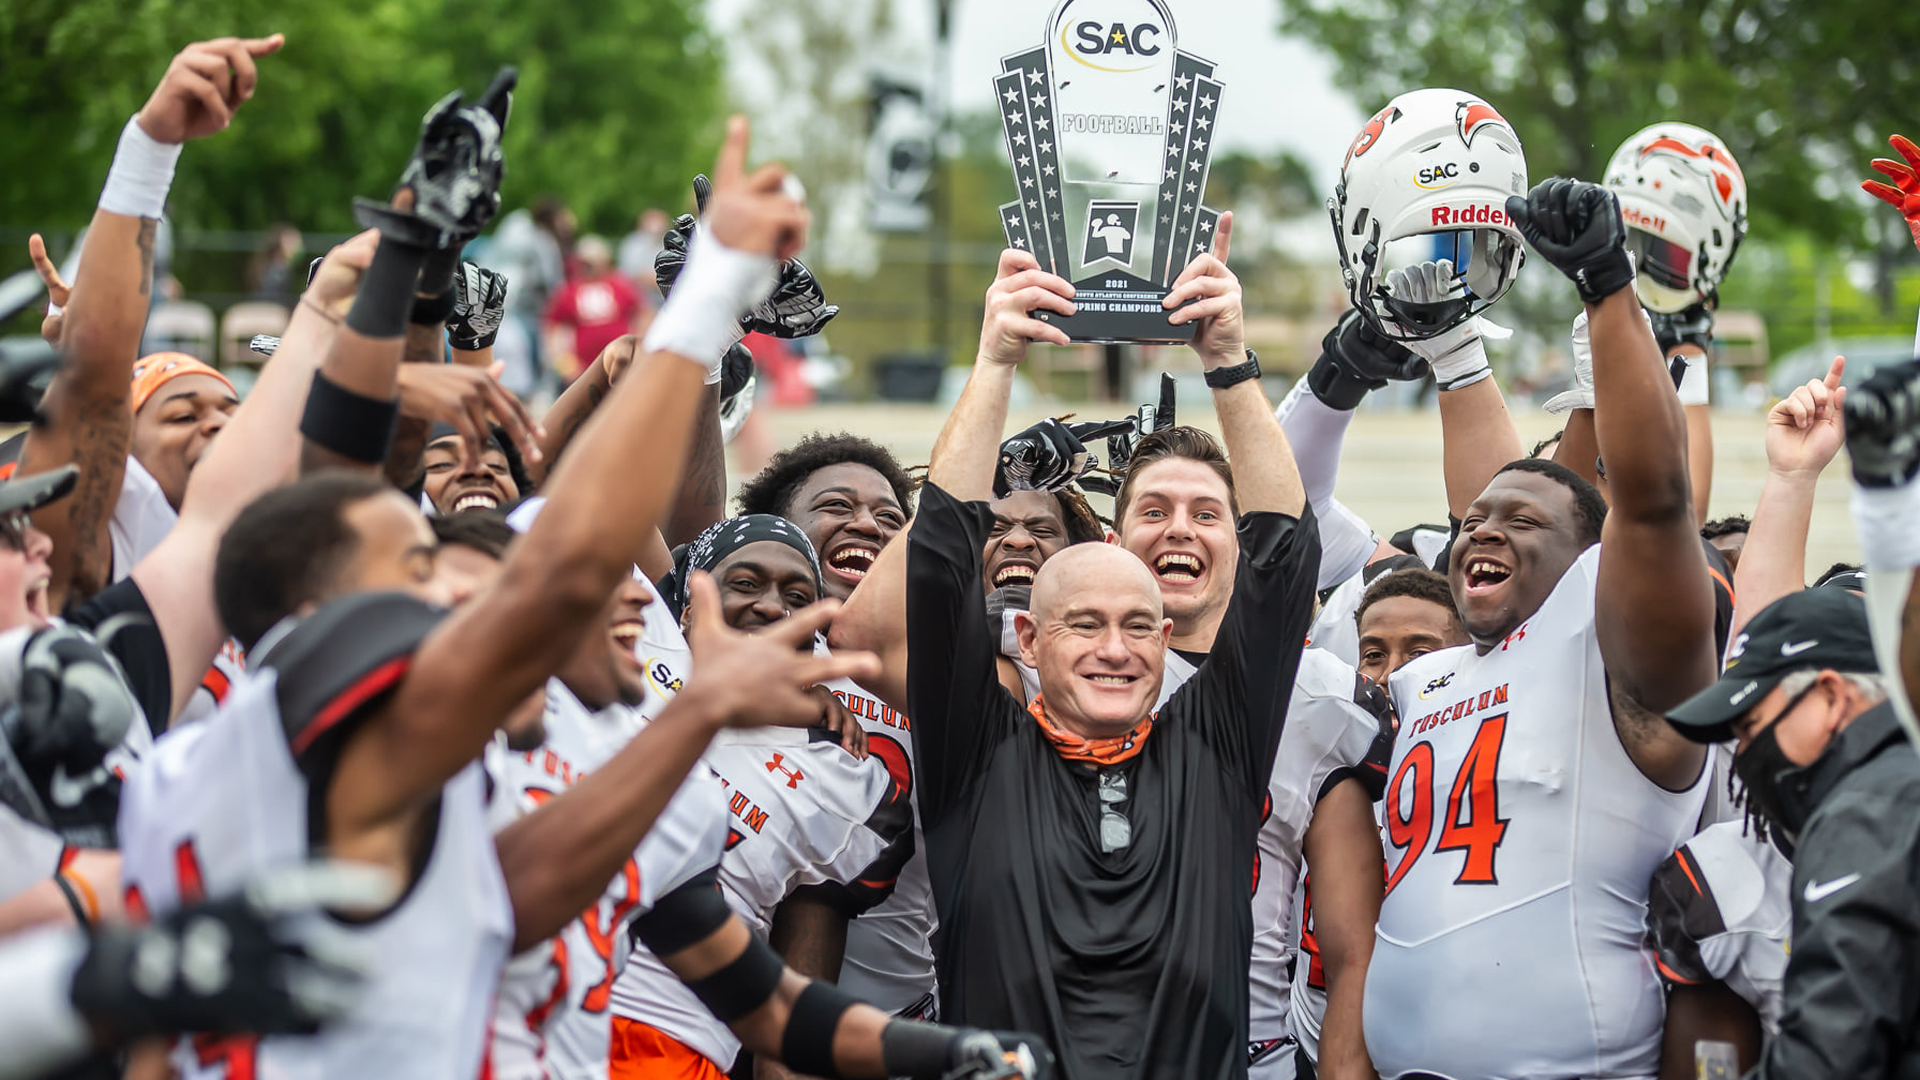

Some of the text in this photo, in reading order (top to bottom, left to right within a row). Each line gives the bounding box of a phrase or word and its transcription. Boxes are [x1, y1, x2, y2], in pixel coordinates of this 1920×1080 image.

[1075, 21, 1161, 56] SAC
[1063, 114, 1164, 135] FOOTBALL
[1419, 162, 1459, 184] SAC
[1620, 206, 1666, 233] ddell
[1105, 280, 1128, 288] 2021
[1109, 303, 1163, 313] CHAMPIONS
[651, 664, 684, 692] SA
[1423, 672, 1455, 694] SAC
[1409, 683, 1509, 739] TUSCULUM
[1384, 711, 1511, 898] 94
